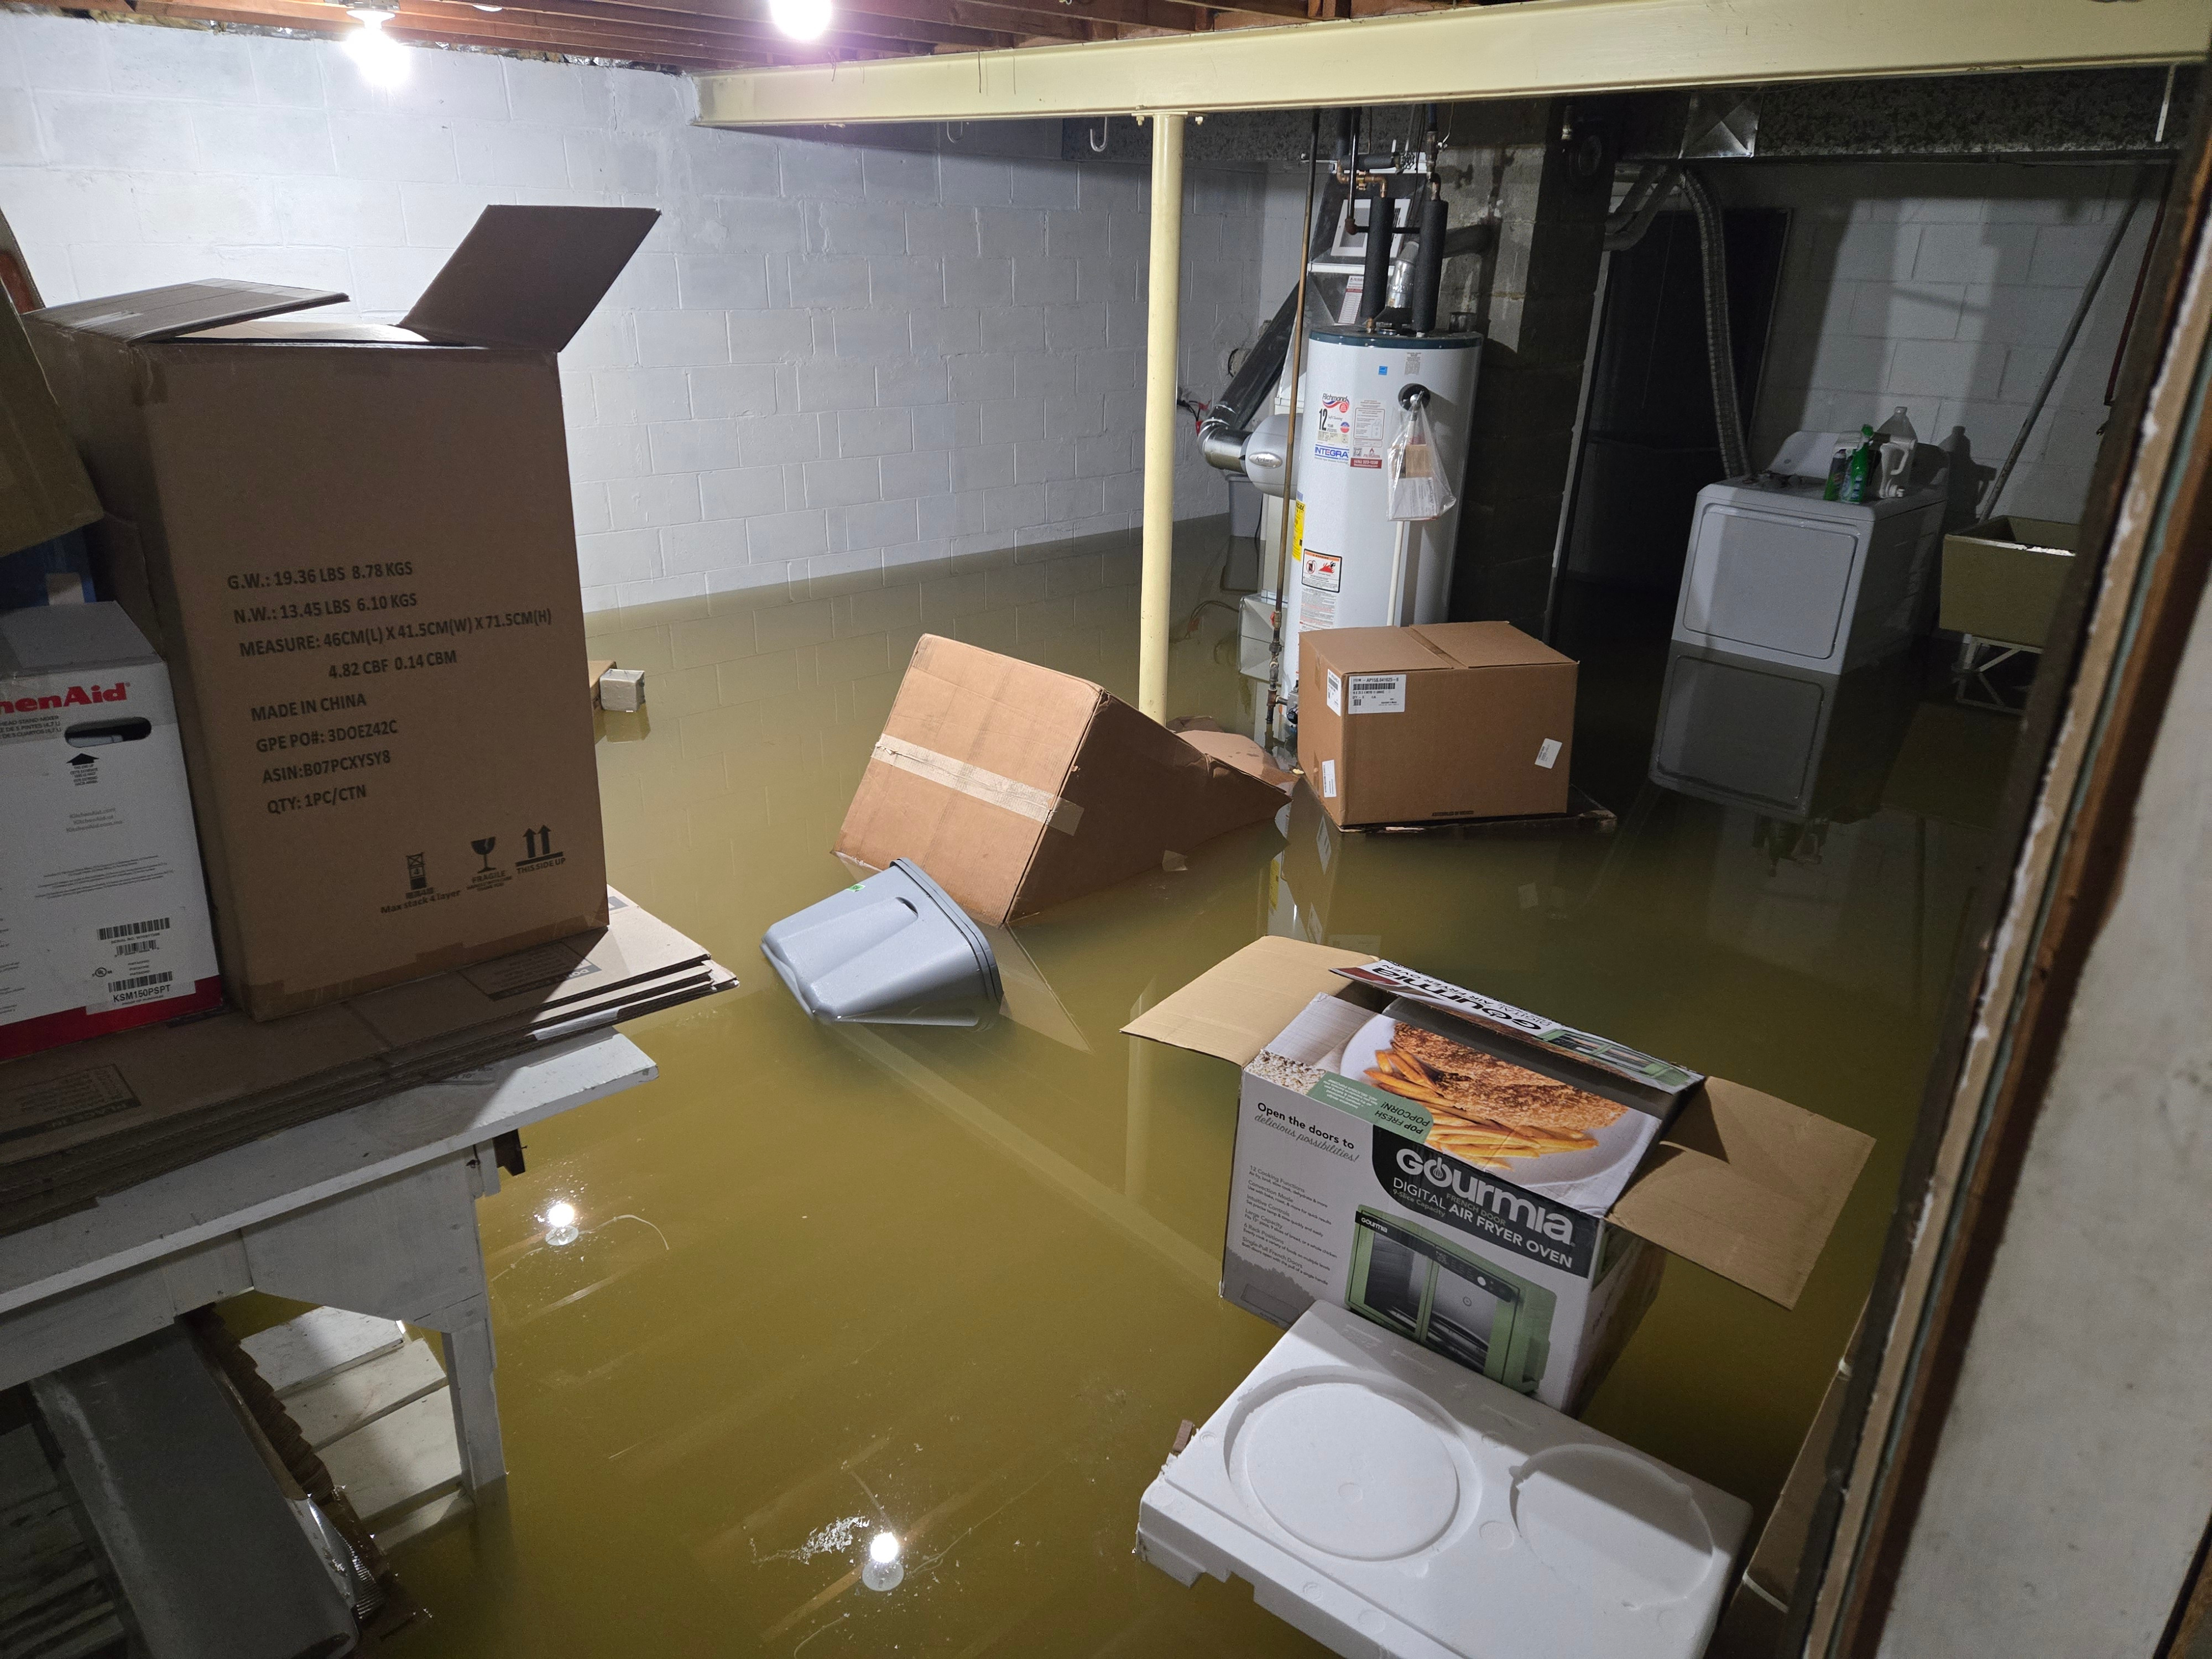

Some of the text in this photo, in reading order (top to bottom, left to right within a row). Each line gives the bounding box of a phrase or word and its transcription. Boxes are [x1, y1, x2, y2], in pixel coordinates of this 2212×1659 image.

[1322, 393, 1348, 402] Richmond
[1319, 409, 1327, 431] 12
[227, 561, 413, 590] G.W.: 19.36 LBS 8.78 KGS
[233, 593, 417, 624] N.W.: 13.45 LBS 6.10 KGS
[238, 608, 552, 657] MEASURE: 46CM(L) X 41.5CM(W) X 71.5CM(H)
[328, 650, 458, 679] 4.82 CBF 0.14 CBM
[251, 693, 367, 722] MADE IN CHINA
[255, 735, 287, 753] GPE
[289, 731, 325, 747] PO#:
[267, 784, 367, 815] QTY: 1PC/CTN
[471, 870, 507, 883] FRAGILE
[517, 857, 566, 875] THIS SIDE UP
[380, 904, 401, 914] Max
[403, 896, 429, 909] stack
[437, 890, 461, 901] layer
[1383, 964, 1421, 979] OVEN
[113, 984, 171, 1003] KSM150PSPT
[1258, 1102, 1354, 1149] Open the doors to
[1374, 1110, 1424, 1134] POP FRESH
[1380, 1102, 1431, 1127] POPCORN!
[1254, 1114, 1360, 1162] delicious possibilities!
[1248, 1179, 1293, 1203] Convection Mode
[1258, 1168, 1279, 1183] Cooking
[1280, 1178, 1305, 1193] Functions
[1246, 1193, 1290, 1217] Intuitive Controls
[1293, 1190, 1312, 1202] dehydrate
[1392, 1188, 1446, 1217] 9-Slice Capacity
[1245, 1208, 1282, 1229] Large Capacity
[1266, 1209, 1277, 1217] temp
[1318, 1216, 1332, 1225] results
[1447, 1193, 1506, 1225] FRENCH DOOR
[1248, 1224, 1260, 1234] Rack
[1261, 1230, 1284, 1244] Positions
[1394, 1177, 1572, 1268] DIGITAL AIR FRYER OVEN
[1242, 1237, 1303, 1269] Single-Pull French Doors
[1269, 1240, 1281, 1249] variety
[1303, 1256, 1319, 1266] multiple
